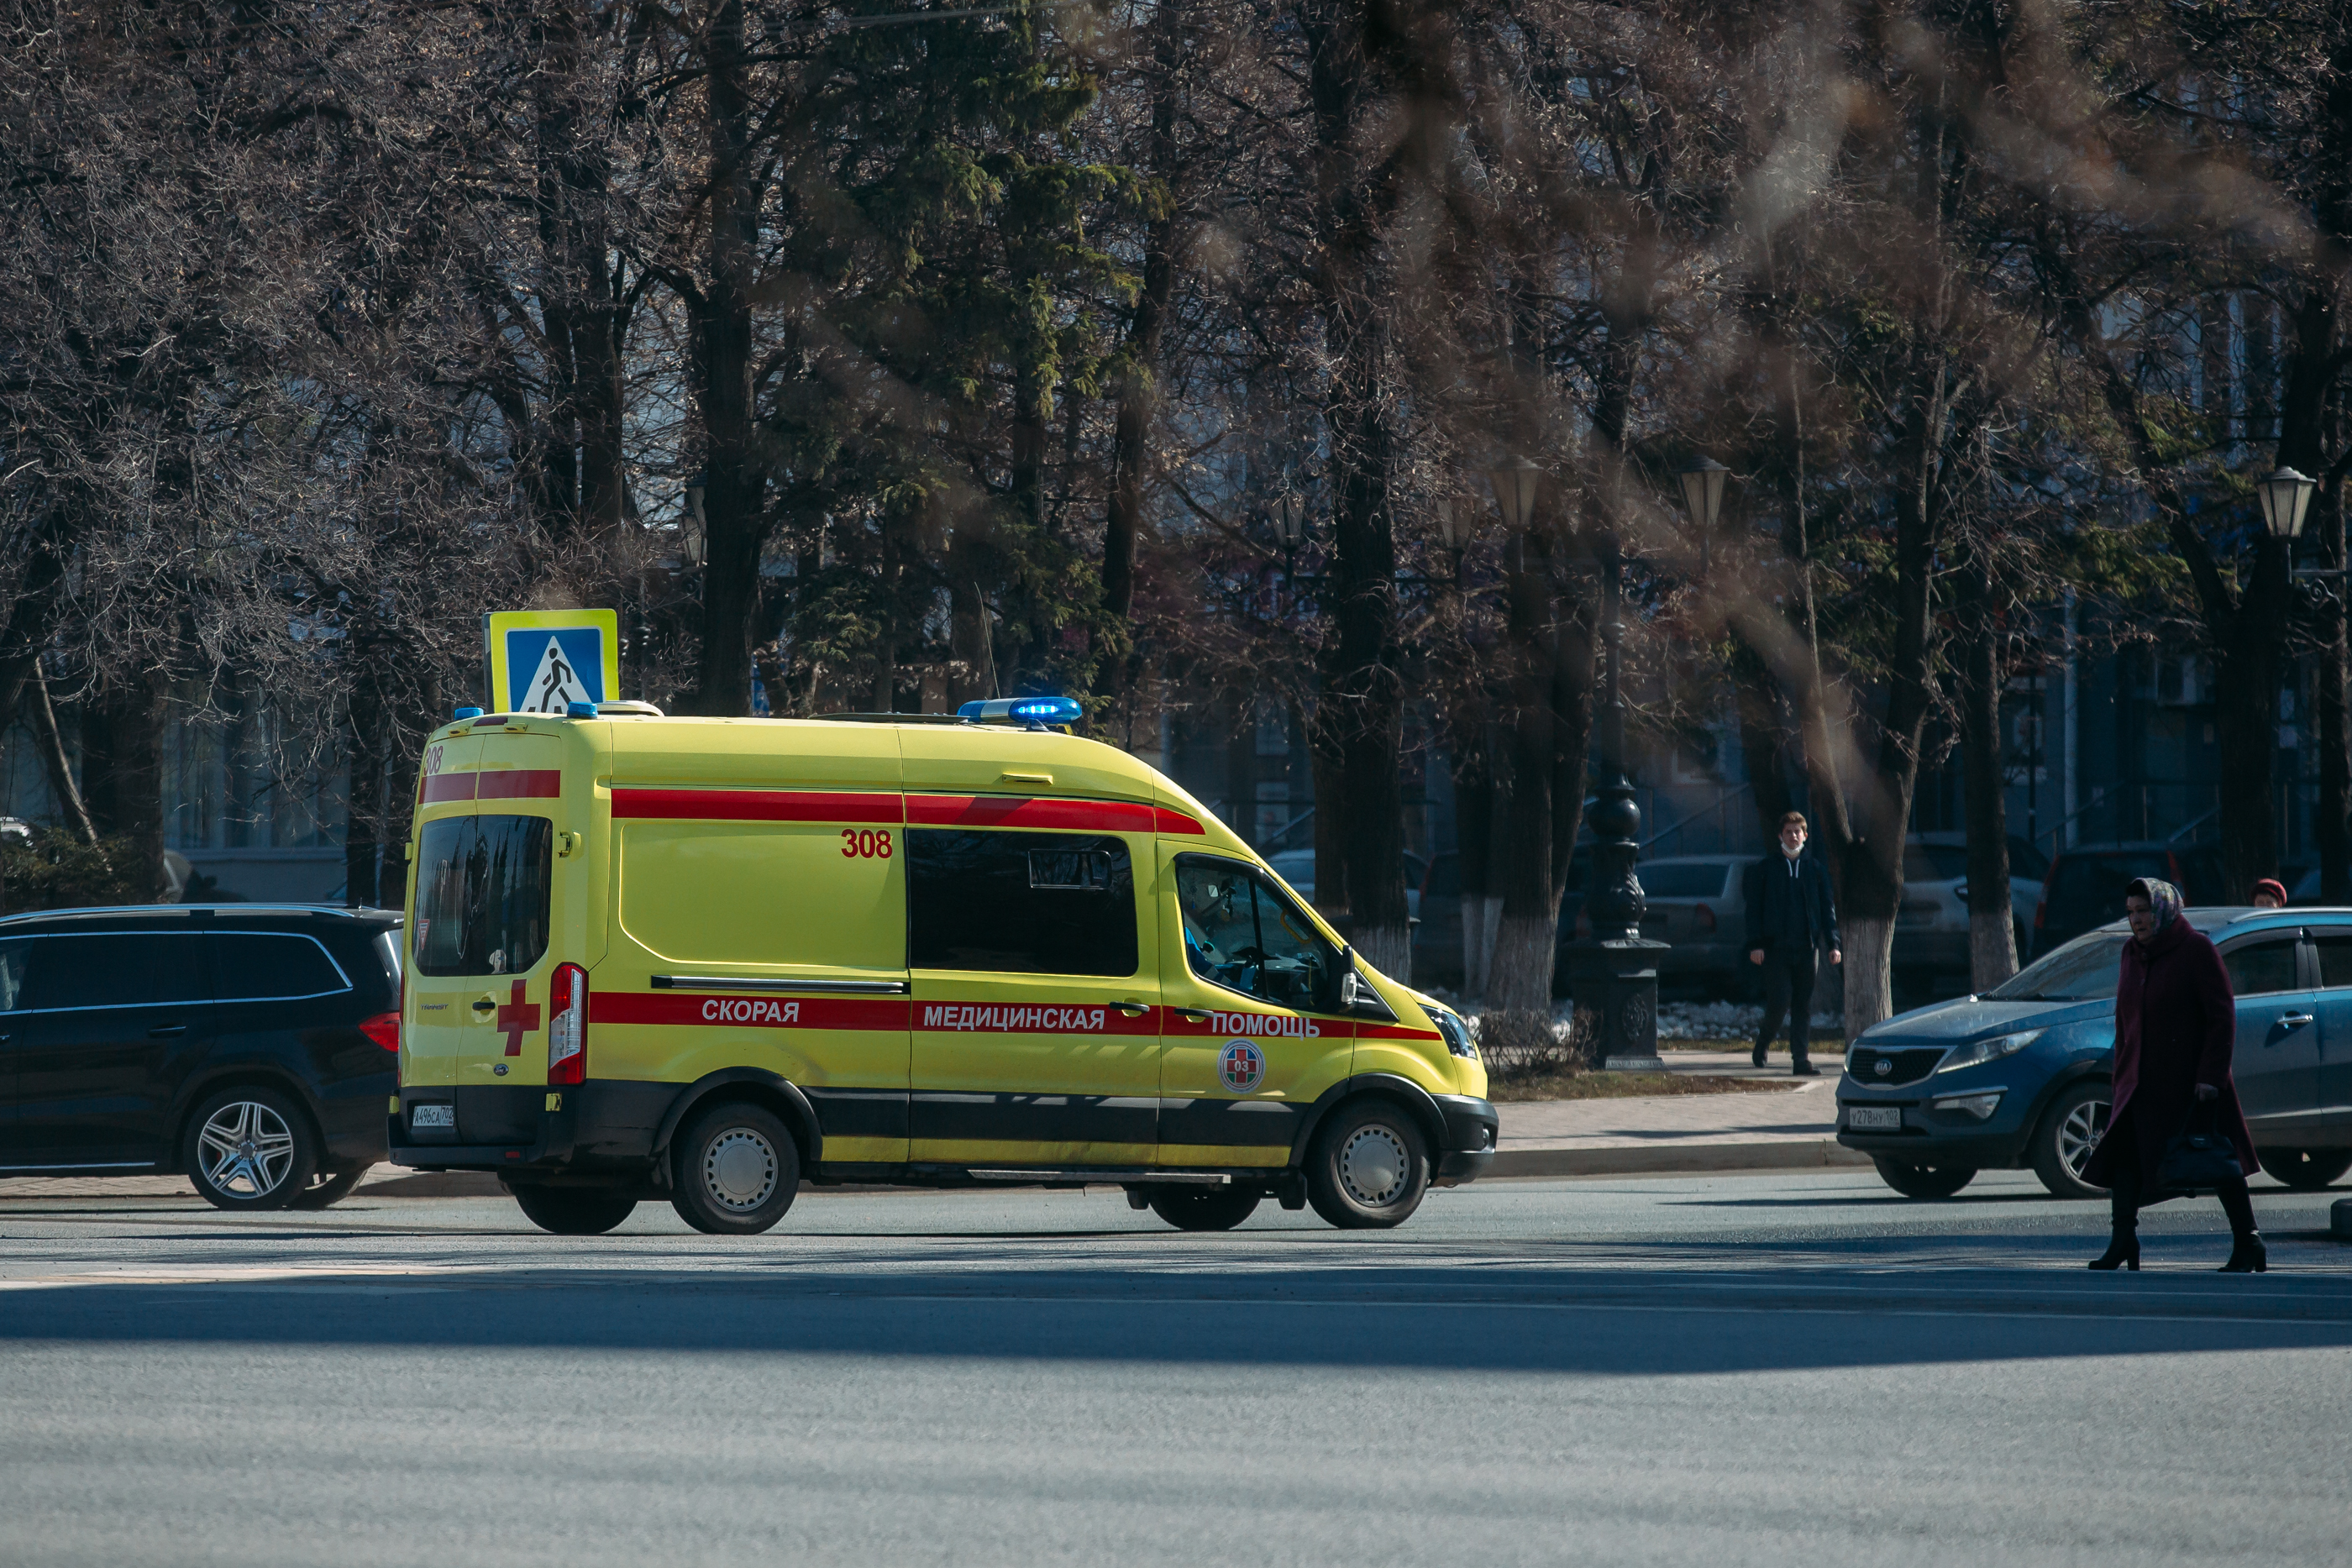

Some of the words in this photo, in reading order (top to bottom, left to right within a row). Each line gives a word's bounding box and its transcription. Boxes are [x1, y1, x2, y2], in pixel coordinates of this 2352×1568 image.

[424, 746, 444, 776] 308
[841, 828, 893, 859] 308
[702, 999, 800, 1022] СКОРАЯ
[924, 1006, 1105, 1031] МЕДИЦИНСКАЯ
[1212, 1012, 1320, 1041] ПОМОЩЬ
[1234, 1060, 1249, 1072] 03
